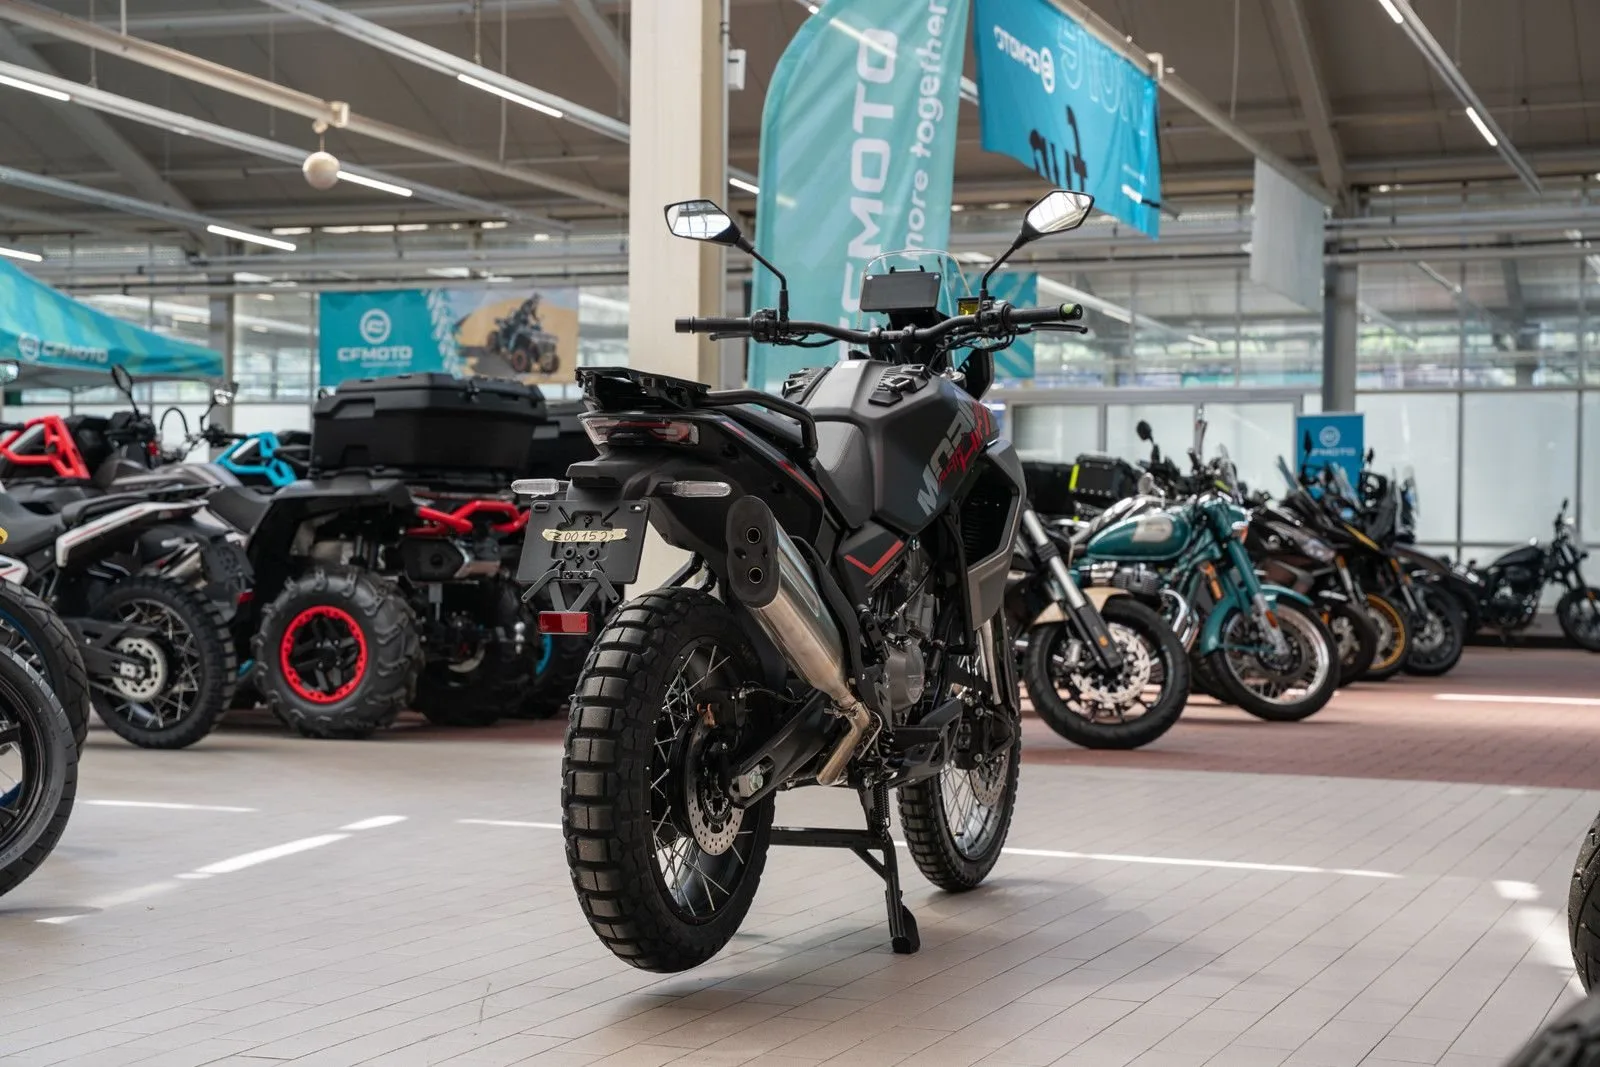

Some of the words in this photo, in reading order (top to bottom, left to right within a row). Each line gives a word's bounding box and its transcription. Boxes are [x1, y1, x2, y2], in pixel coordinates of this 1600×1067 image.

[910, 0, 948, 158] together
[901, 170, 929, 261] more
[337, 346, 412, 362] CFMOTO
[1304, 447, 1356, 456] FMOTO
